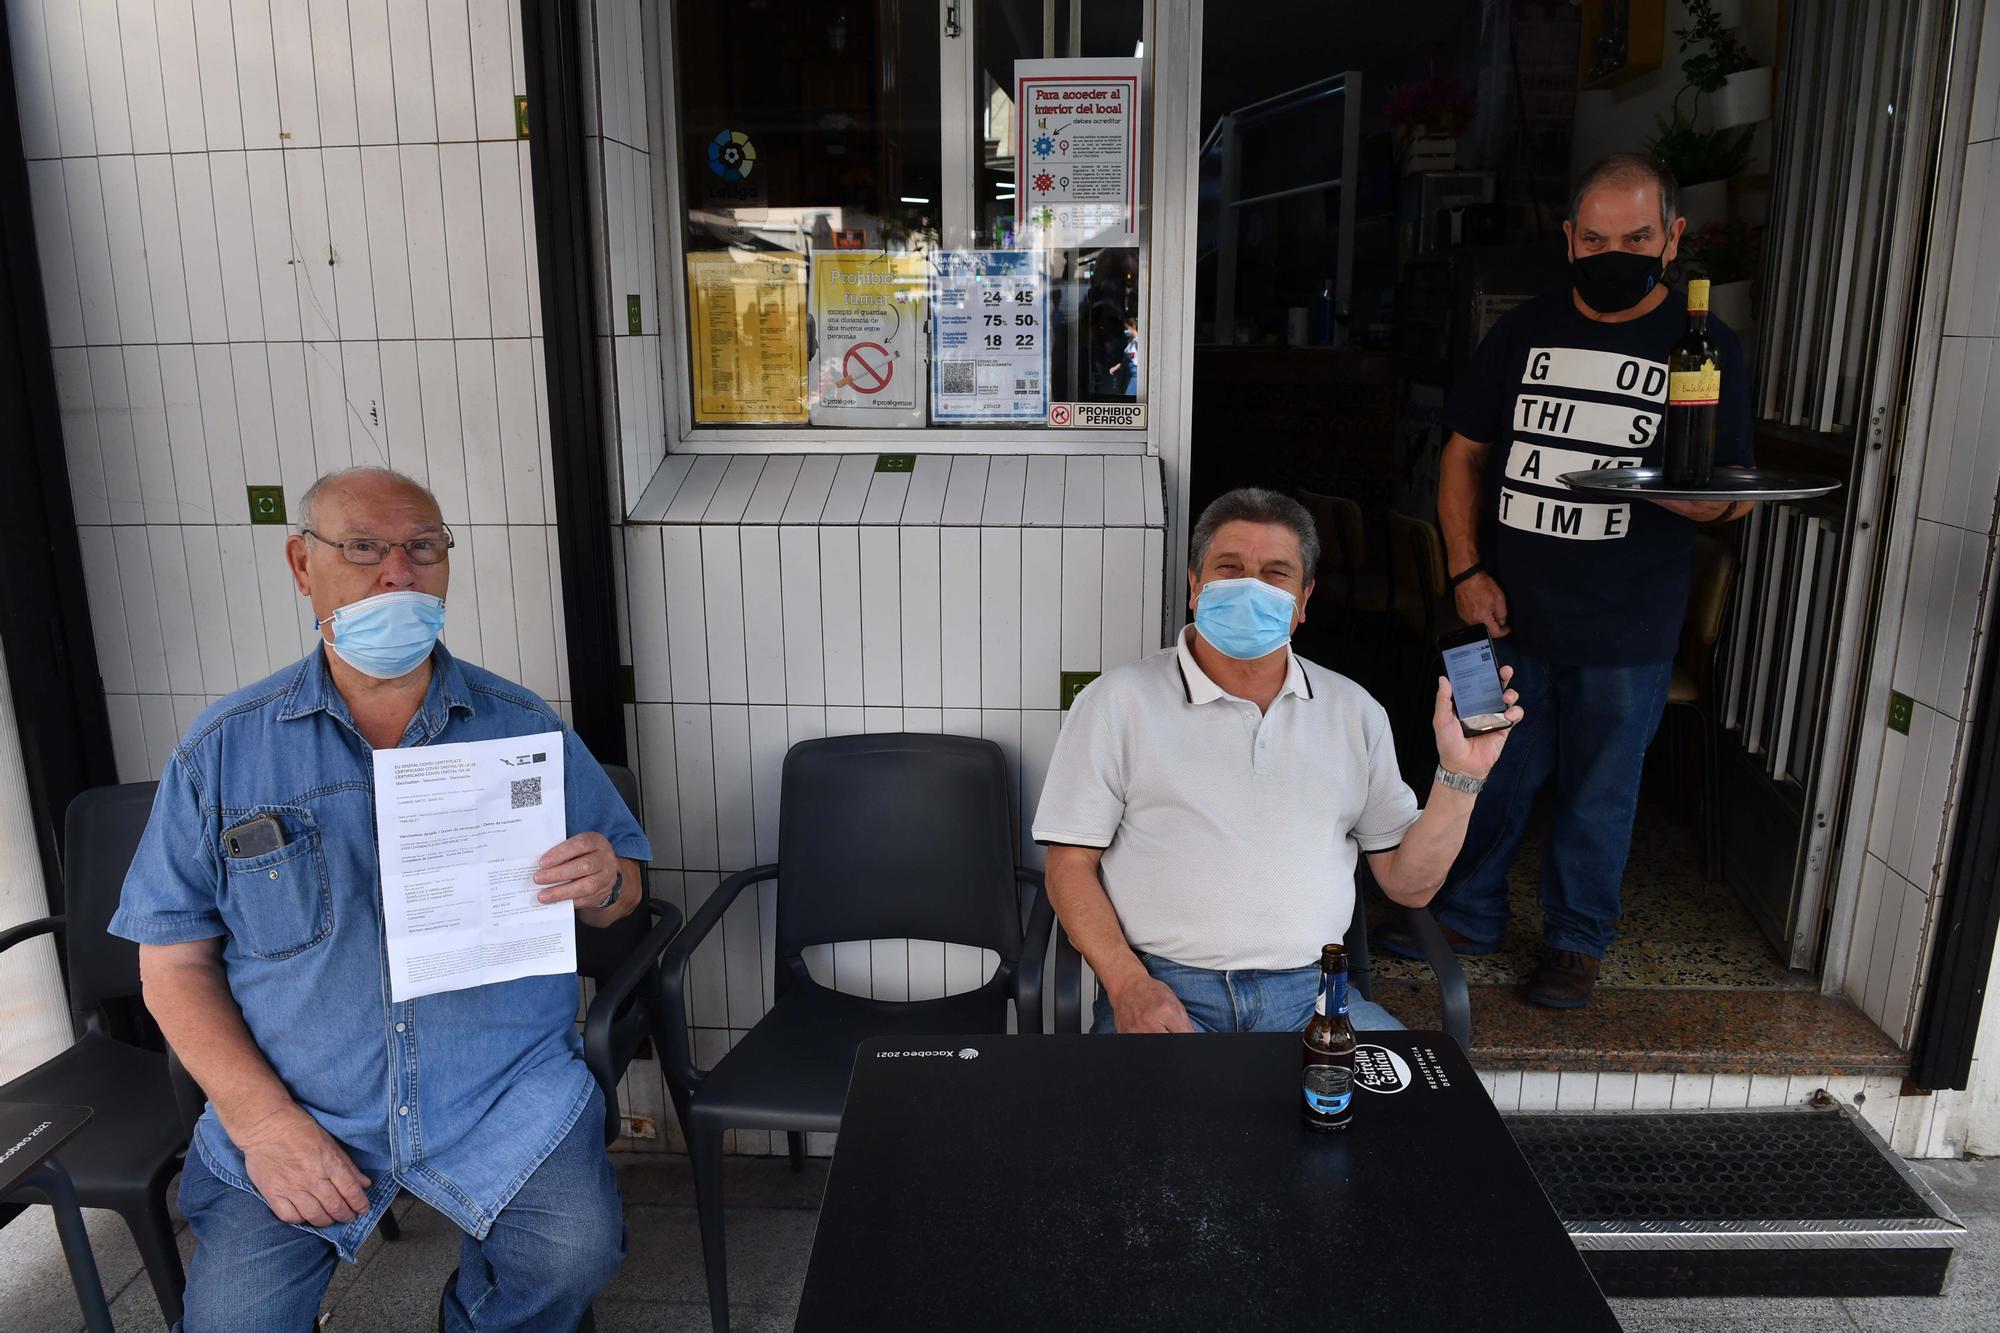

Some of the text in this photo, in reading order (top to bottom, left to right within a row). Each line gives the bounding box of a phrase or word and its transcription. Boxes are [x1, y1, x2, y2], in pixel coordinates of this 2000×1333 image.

[1036, 89, 1121, 100] Para acceder al
[1035, 103, 1122, 115] interior del local
[831, 270, 904, 286] Prohibido
[844, 291, 891, 305] fumar
[983, 291, 1034, 303] 24 45
[827, 309, 853, 317] excepto
[860, 309, 887, 317] guardas
[984, 335, 1034, 346] 18 22
[1078, 407, 1141, 416] PROHIBIDO
[1086, 416, 1133, 425] PERROS
[902, 1050, 954, 1058] Xacobeo
[1356, 1050, 1381, 1085] Estrella
[1371, 1052, 1398, 1084] Galicia
[1411, 1046, 1438, 1089] RESISTENCIA
[1425, 1048, 1450, 1087] DESDE 1906
[28, 1121, 52, 1137] 2021
